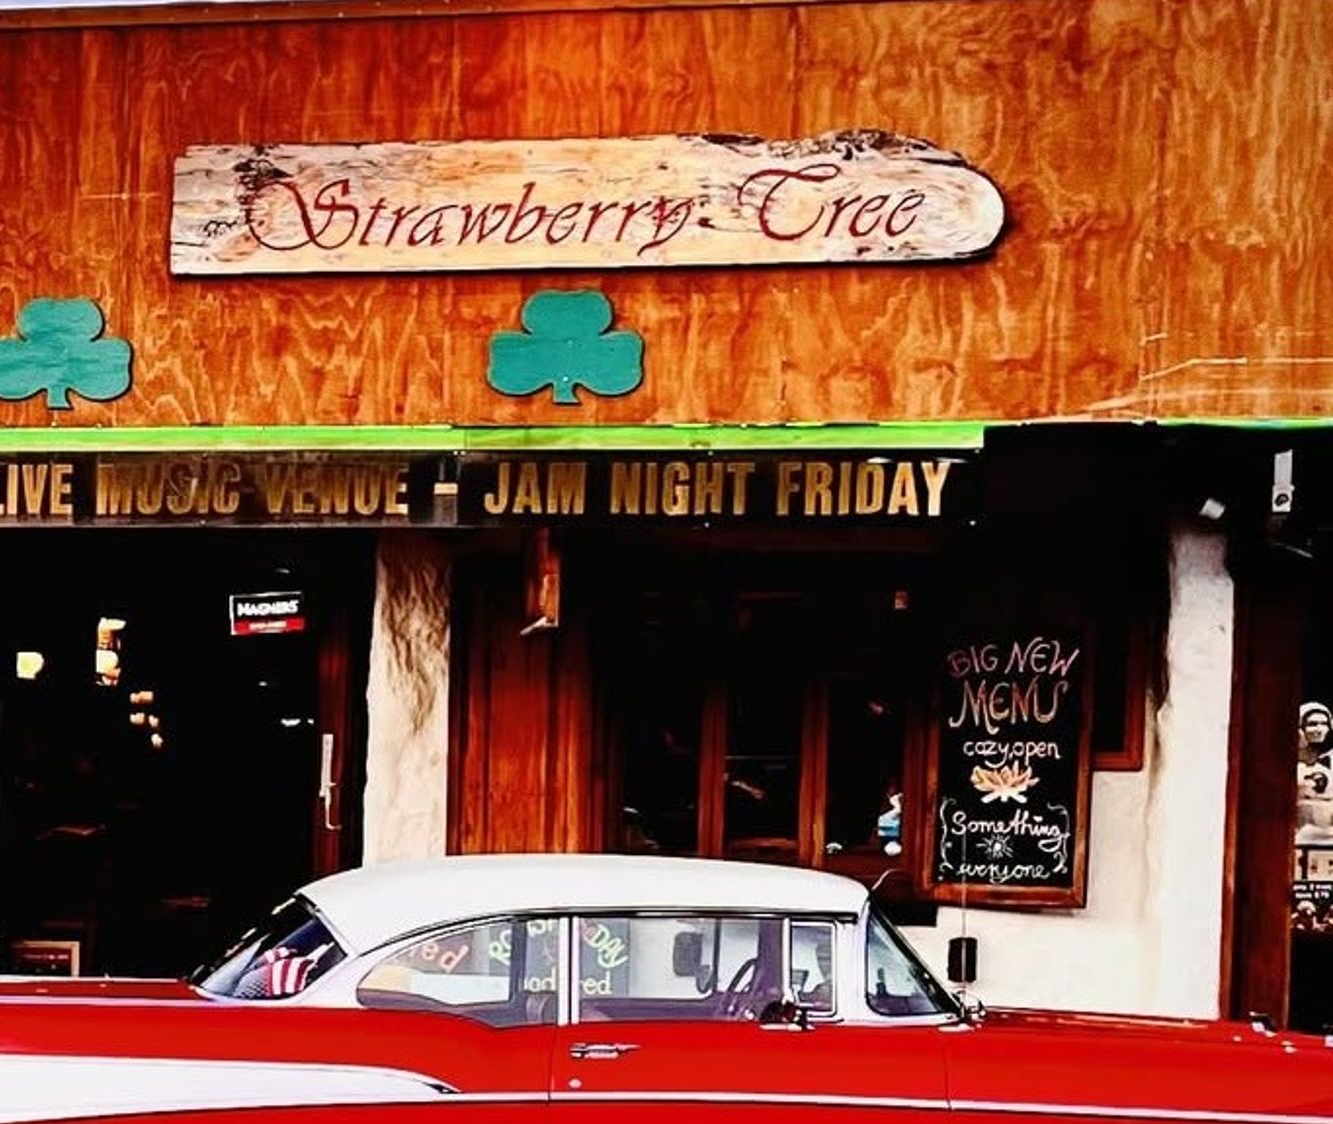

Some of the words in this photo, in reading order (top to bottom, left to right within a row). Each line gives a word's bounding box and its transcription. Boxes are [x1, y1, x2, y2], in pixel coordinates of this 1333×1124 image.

[244, 177, 692, 256] Strawberry
[735, 162, 925, 243] Tree
[95, 462, 241, 515] MUSIC
[264, 462, 409, 515] VENUE
[483, 461, 587, 516] JAM
[610, 461, 755, 516] NIGHT
[776, 460, 951, 517] FRIDAY
[947, 643, 999, 678] BIG
[1003, 636, 1081, 677] NEW
[1012, 740, 1061, 767] open
[951, 808, 1070, 853] Something
